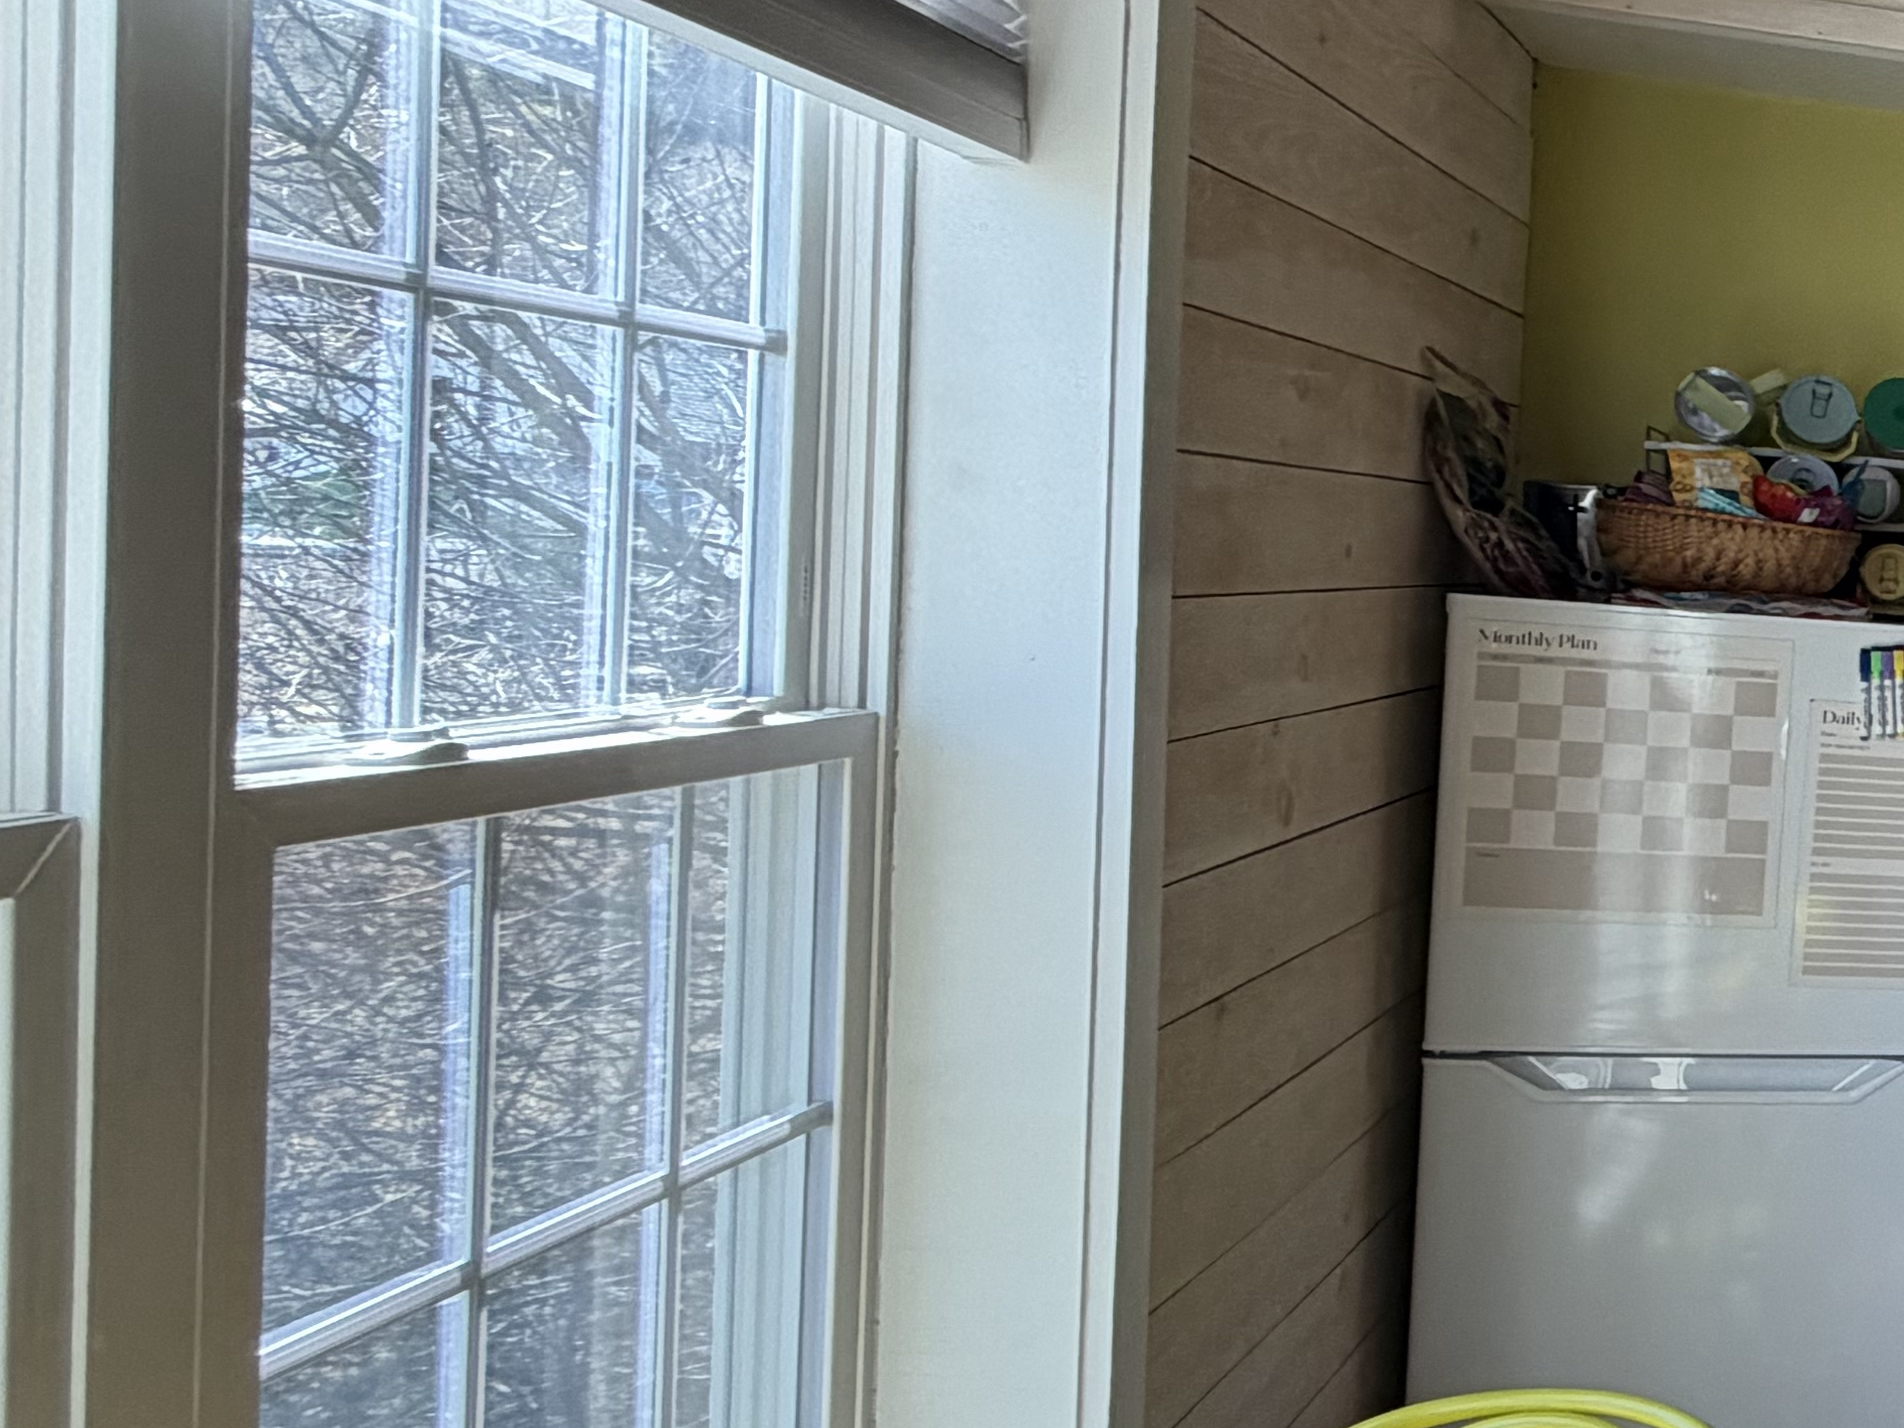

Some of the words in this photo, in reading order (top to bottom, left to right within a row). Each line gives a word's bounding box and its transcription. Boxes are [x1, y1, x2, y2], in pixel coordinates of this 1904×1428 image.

[1478, 628, 1552, 651] Monthly
[1559, 633, 1598, 651] Plan
[1822, 710, 1862, 730] Daily
